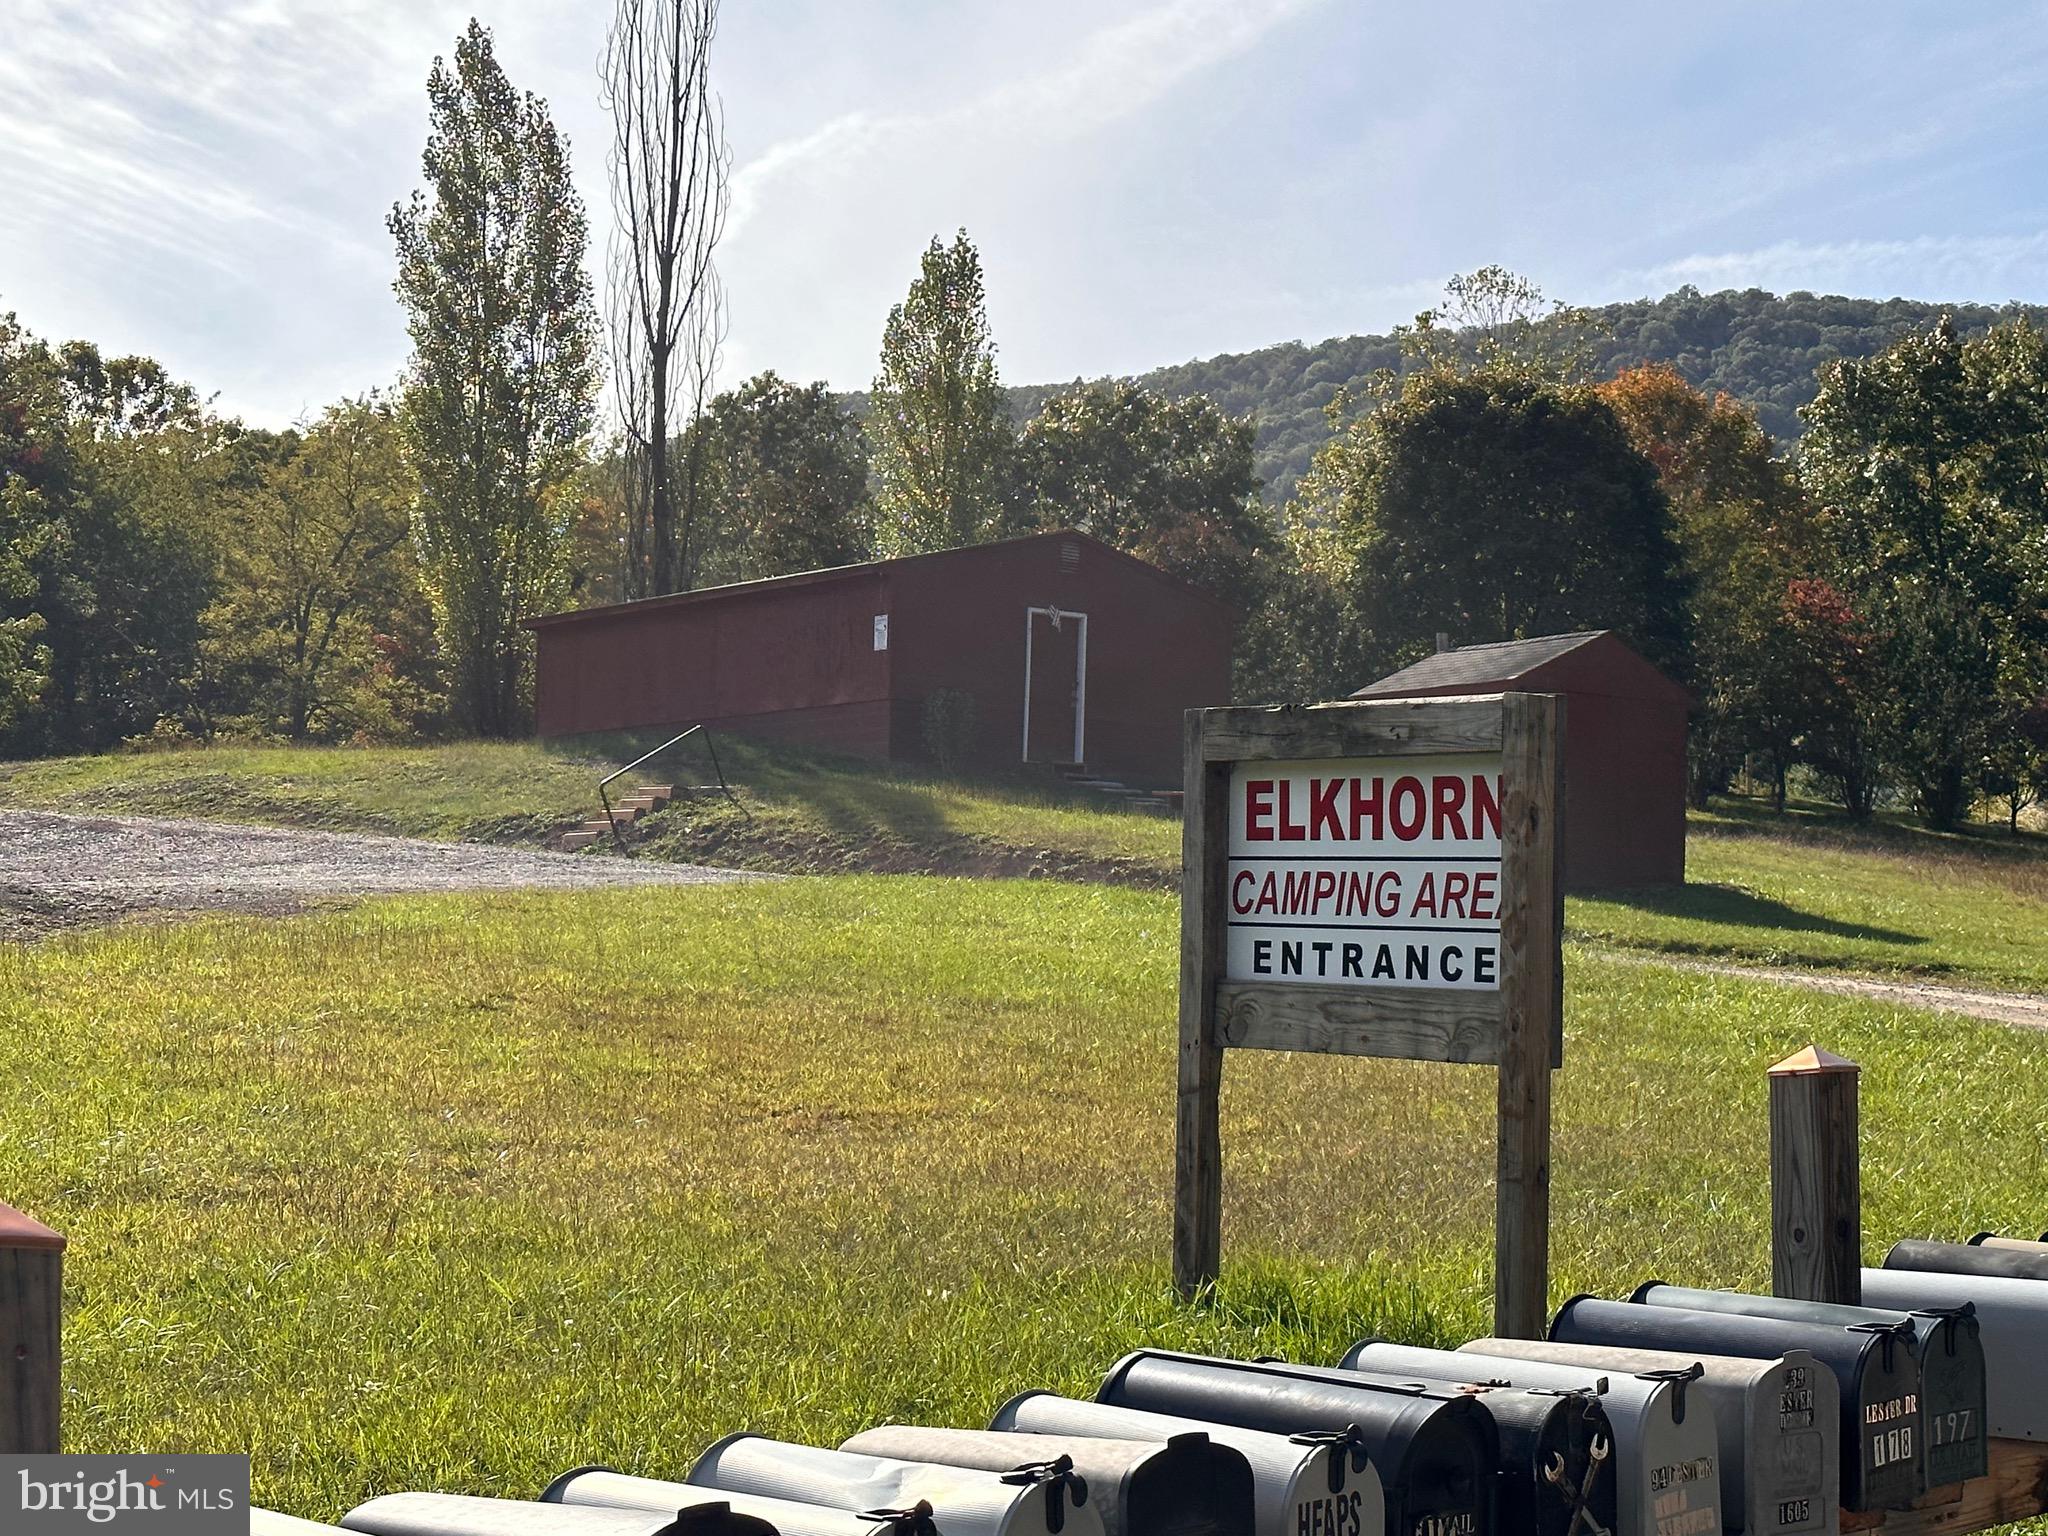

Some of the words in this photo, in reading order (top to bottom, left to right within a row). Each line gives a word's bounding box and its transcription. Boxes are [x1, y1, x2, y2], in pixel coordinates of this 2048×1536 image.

[1246, 775, 1502, 841] ELKHORN
[1232, 870, 1403, 918] CAMPING
[1410, 871, 1502, 920] ARE
[1253, 940, 1496, 983] ENTRANCE
[1904, 1394, 1917, 1414] DR
[1874, 1427, 1911, 1467] 178
[1934, 1410, 1971, 1445] 197
[1298, 1491, 1362, 1536] HEAPS
[1780, 1499, 1808, 1525] 1605
